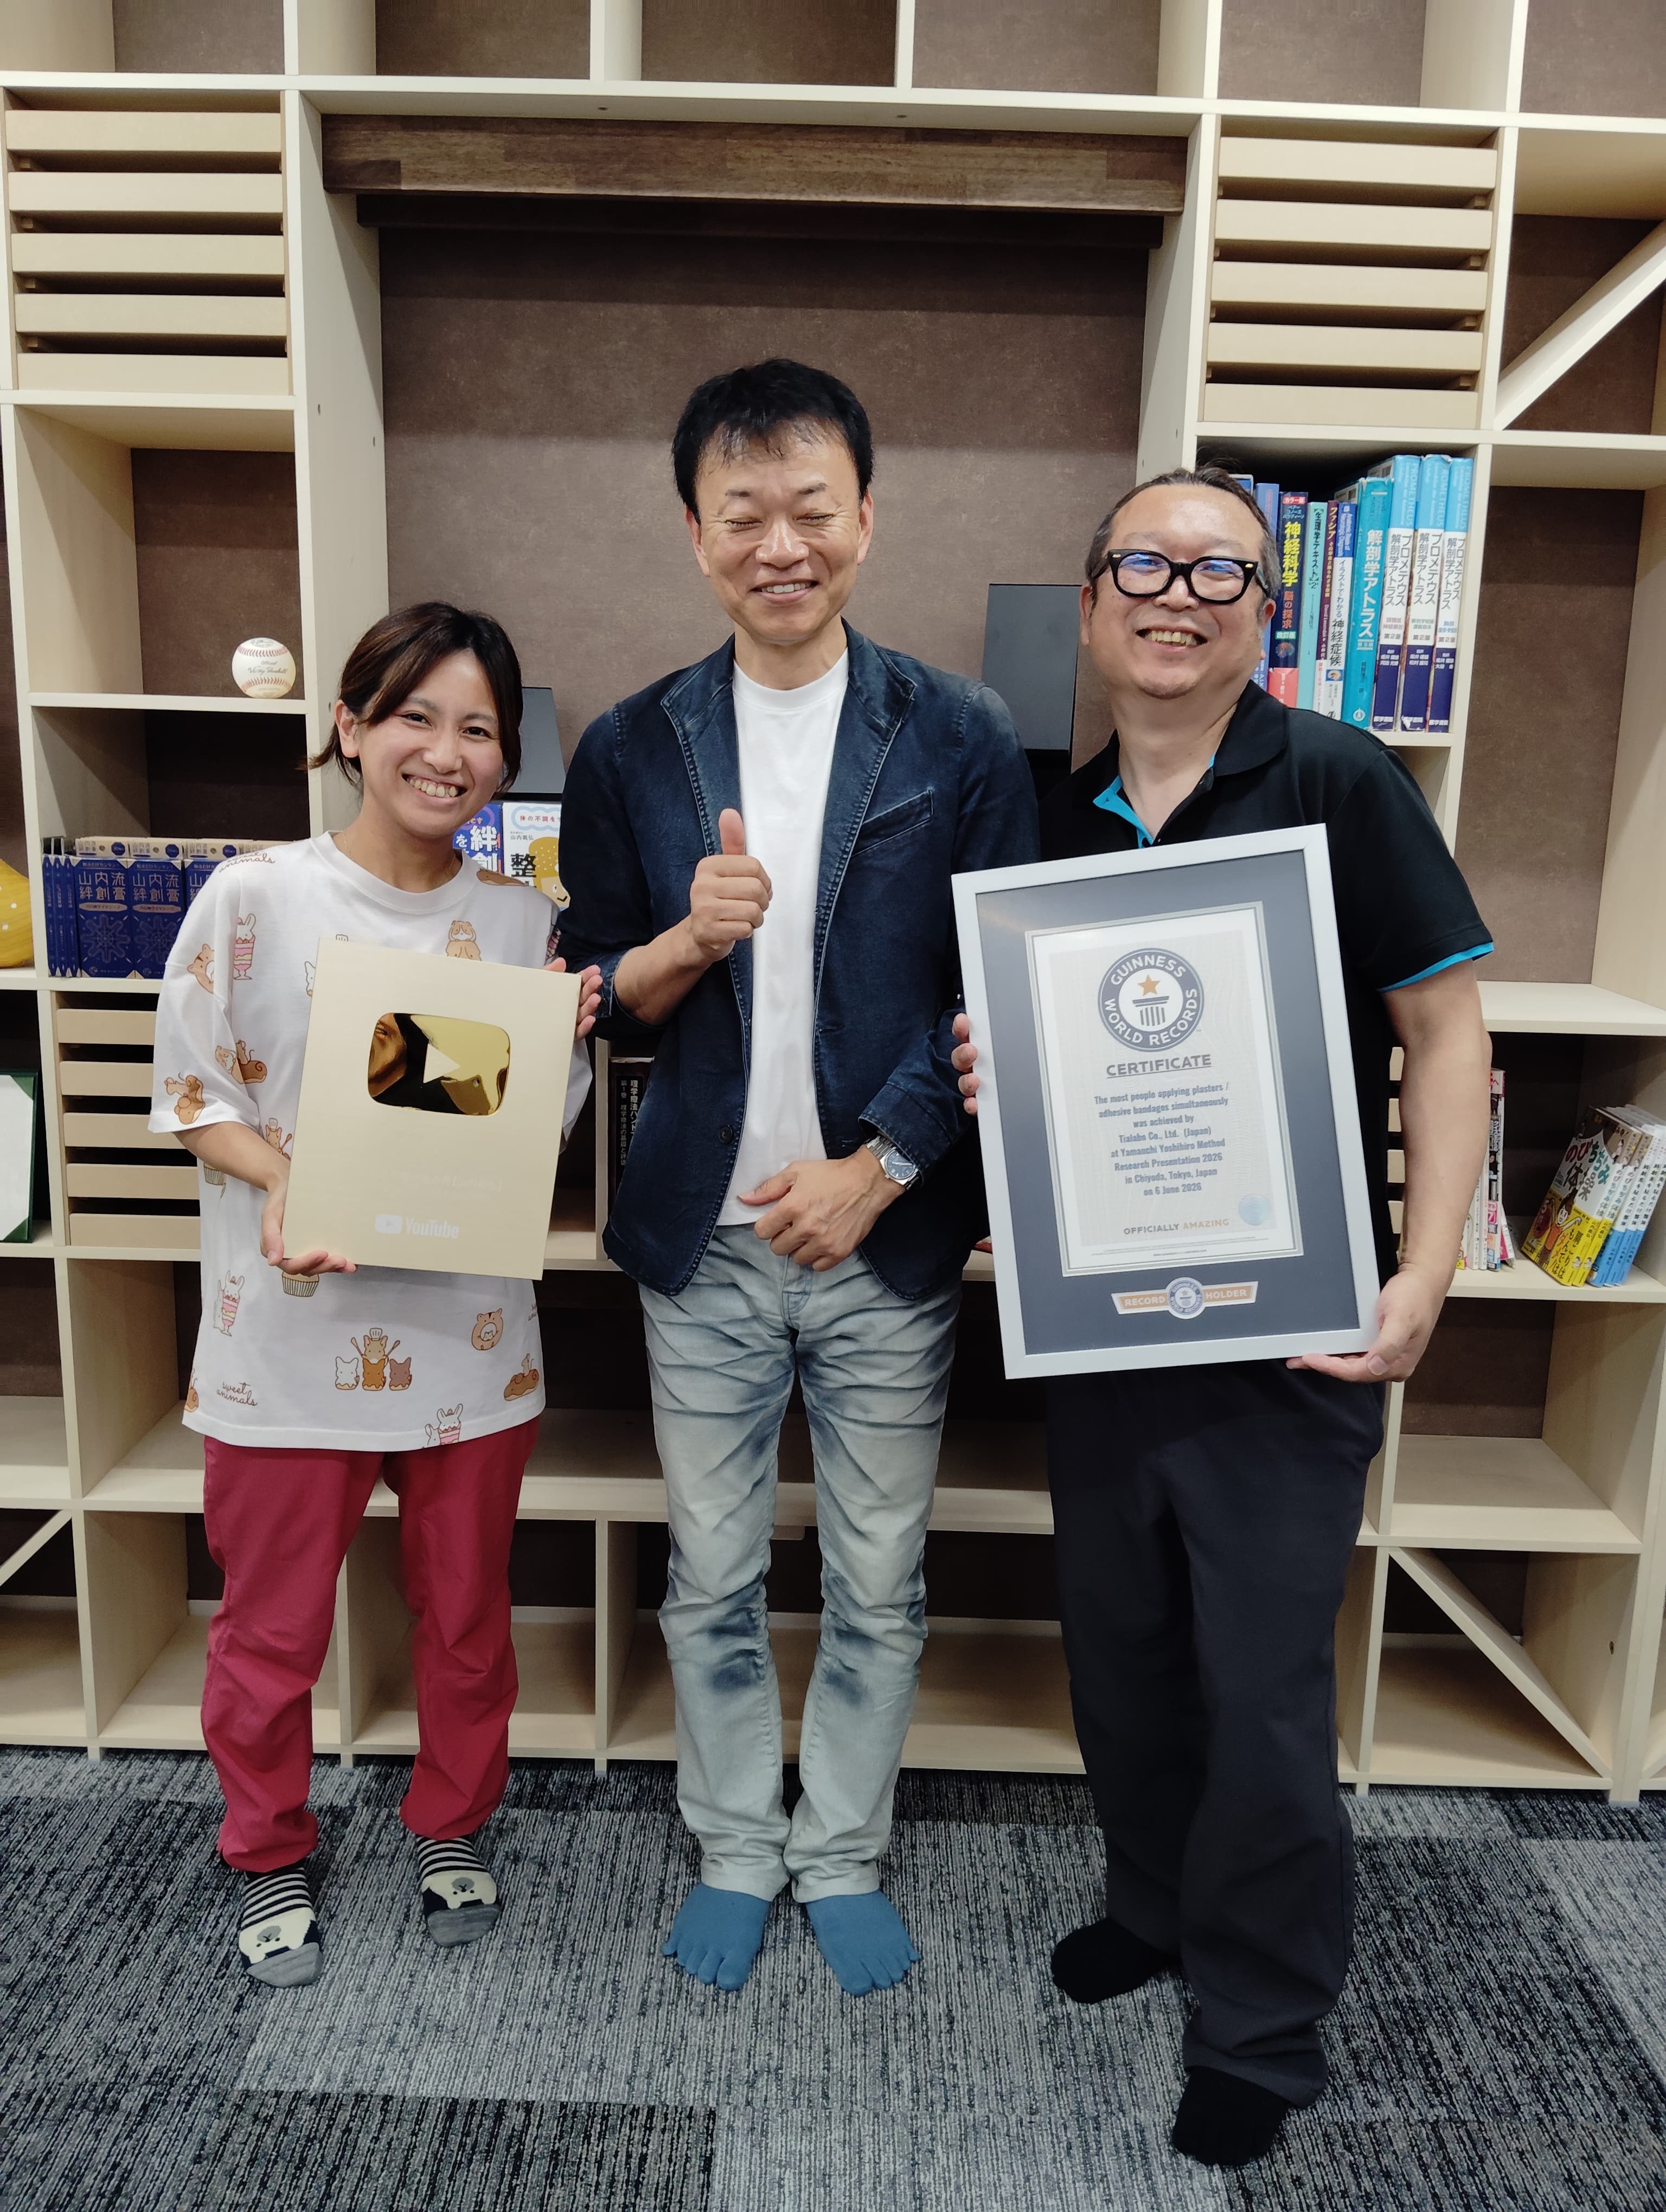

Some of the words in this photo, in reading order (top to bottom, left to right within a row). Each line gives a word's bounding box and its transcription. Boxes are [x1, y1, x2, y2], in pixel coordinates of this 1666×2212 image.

[1328, 507, 1338, 539] ファシア
[1281, 521, 1301, 588] 神経科学
[1385, 533, 1402, 606] 解剖学アトラス
[1395, 535, 1412, 606] プロメテウス
[1413, 532, 1431, 605] 解剖学アトラス
[1425, 533, 1443, 605] プロメテウス
[1441, 537, 1458, 610] 解剖学アトラス
[1452, 538, 1466, 601] プロメテウス
[1336, 560, 1347, 618] イラストでわかる
[1281, 590, 1294, 629] 脳の探求
[1330, 618, 1345, 667] 神経症候
[219, 853, 275, 873] animals
[510, 853, 536, 888] 整
[79, 871, 126, 886] 山内流
[132, 873, 179, 888] 山内流
[79, 886, 126, 901] 絆創膏
[133, 888, 180, 903] 絆創膏
[1111, 954, 1187, 985] GUINNESS
[1104, 998, 1143, 1043] WORLD
[1149, 988, 1197, 1046] RECORDS
[1106, 1053, 1212, 1076] CERTIFICATE
[1094, 1096, 1107, 1104] The
[1110, 1094, 1129, 1103] most
[1131, 1091, 1156, 1102] people
[1158, 1087, 1190, 1098] applying
[1193, 1084, 1223, 1097] plasters
[1099, 1107, 1131, 1118] adhesive
[1133, 1104, 1169, 1114] bandages
[1171, 1097, 1228, 1111] simultaneously
[1149, 1115, 1183, 1127] achieved
[1185, 1114, 1194, 1124] by
[1118, 1133, 1146, 1144] Tialabo
[1148, 1131, 1163, 1140] Co.,
[1164, 1130, 1180, 1139] Ltd.
[1184, 1126, 1212, 1138] (Japan)
[1111, 1150, 1119, 1158] at
[1120, 1146, 1157, 1157] Yamauchi
[1159, 1143, 1195, 1153] Yoshihiro
[1196, 1138, 1225, 1149] Method
[1114, 1160, 1150, 1171] Research
[1151, 1156, 1201, 1168] Presentation
[1202, 1153, 1223, 1162] 2026
[1565, 1139, 1610, 1185] のびちぢみ
[1125, 1175, 1133, 1184] in
[1134, 1172, 1167, 1184] Chiyoda,
[1168, 1171, 1194, 1180] Tokyo,
[1195, 1168, 1218, 1178] Japan
[1155, 1186, 1161, 1195] 6
[1162, 1186, 1180, 1194] June
[1181, 1182, 1202, 1193] 2026
[406, 1216, 460, 1239] YouTube
[1123, 1223, 1180, 1235] OFFICIALLY
[1183, 1218, 1229, 1230] AMAZING
[1124, 1296, 1166, 1307] RECORD
[1205, 1289, 1247, 1300] HOLDER
[216, 1389, 258, 1406] animals
[222, 1381, 251, 1395] sweet
